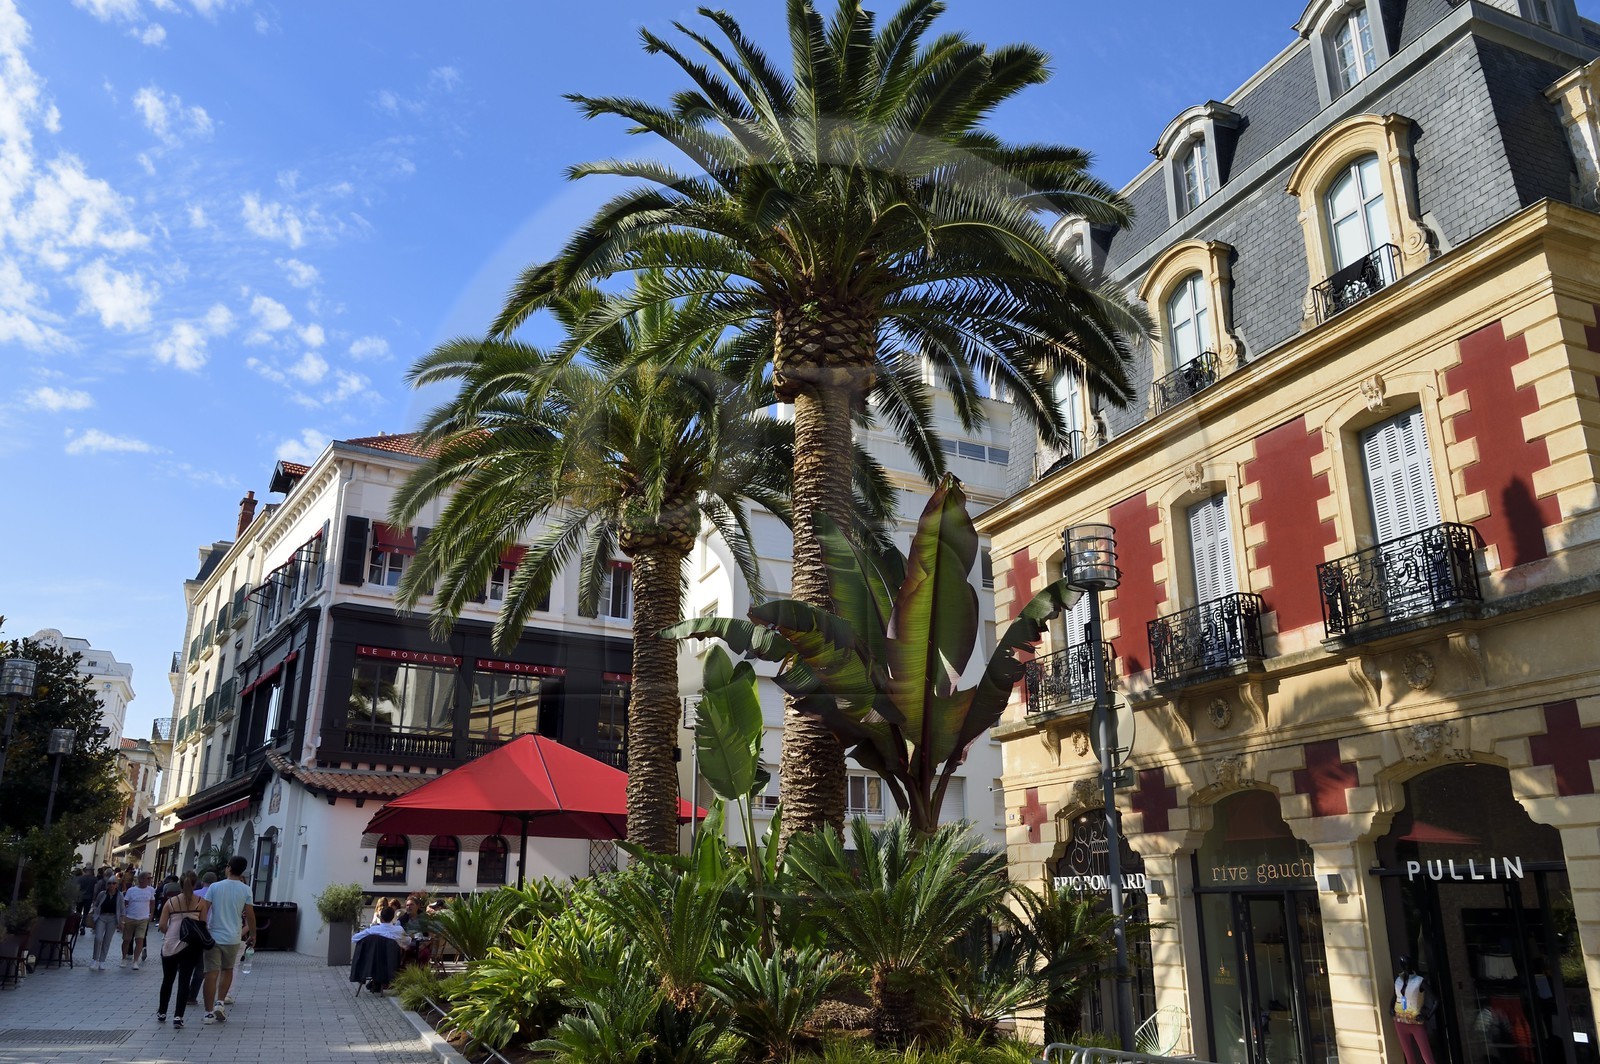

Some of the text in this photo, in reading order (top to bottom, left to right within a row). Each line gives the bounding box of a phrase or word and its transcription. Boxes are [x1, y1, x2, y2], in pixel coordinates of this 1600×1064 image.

[362, 647, 458, 664] LE ROYALTY
[478, 660, 567, 675] LE ROYALTY
[1212, 858, 1315, 884] rive gauch
[1406, 856, 1524, 881] PULLIN
[1083, 873, 1146, 891] BOMARD
